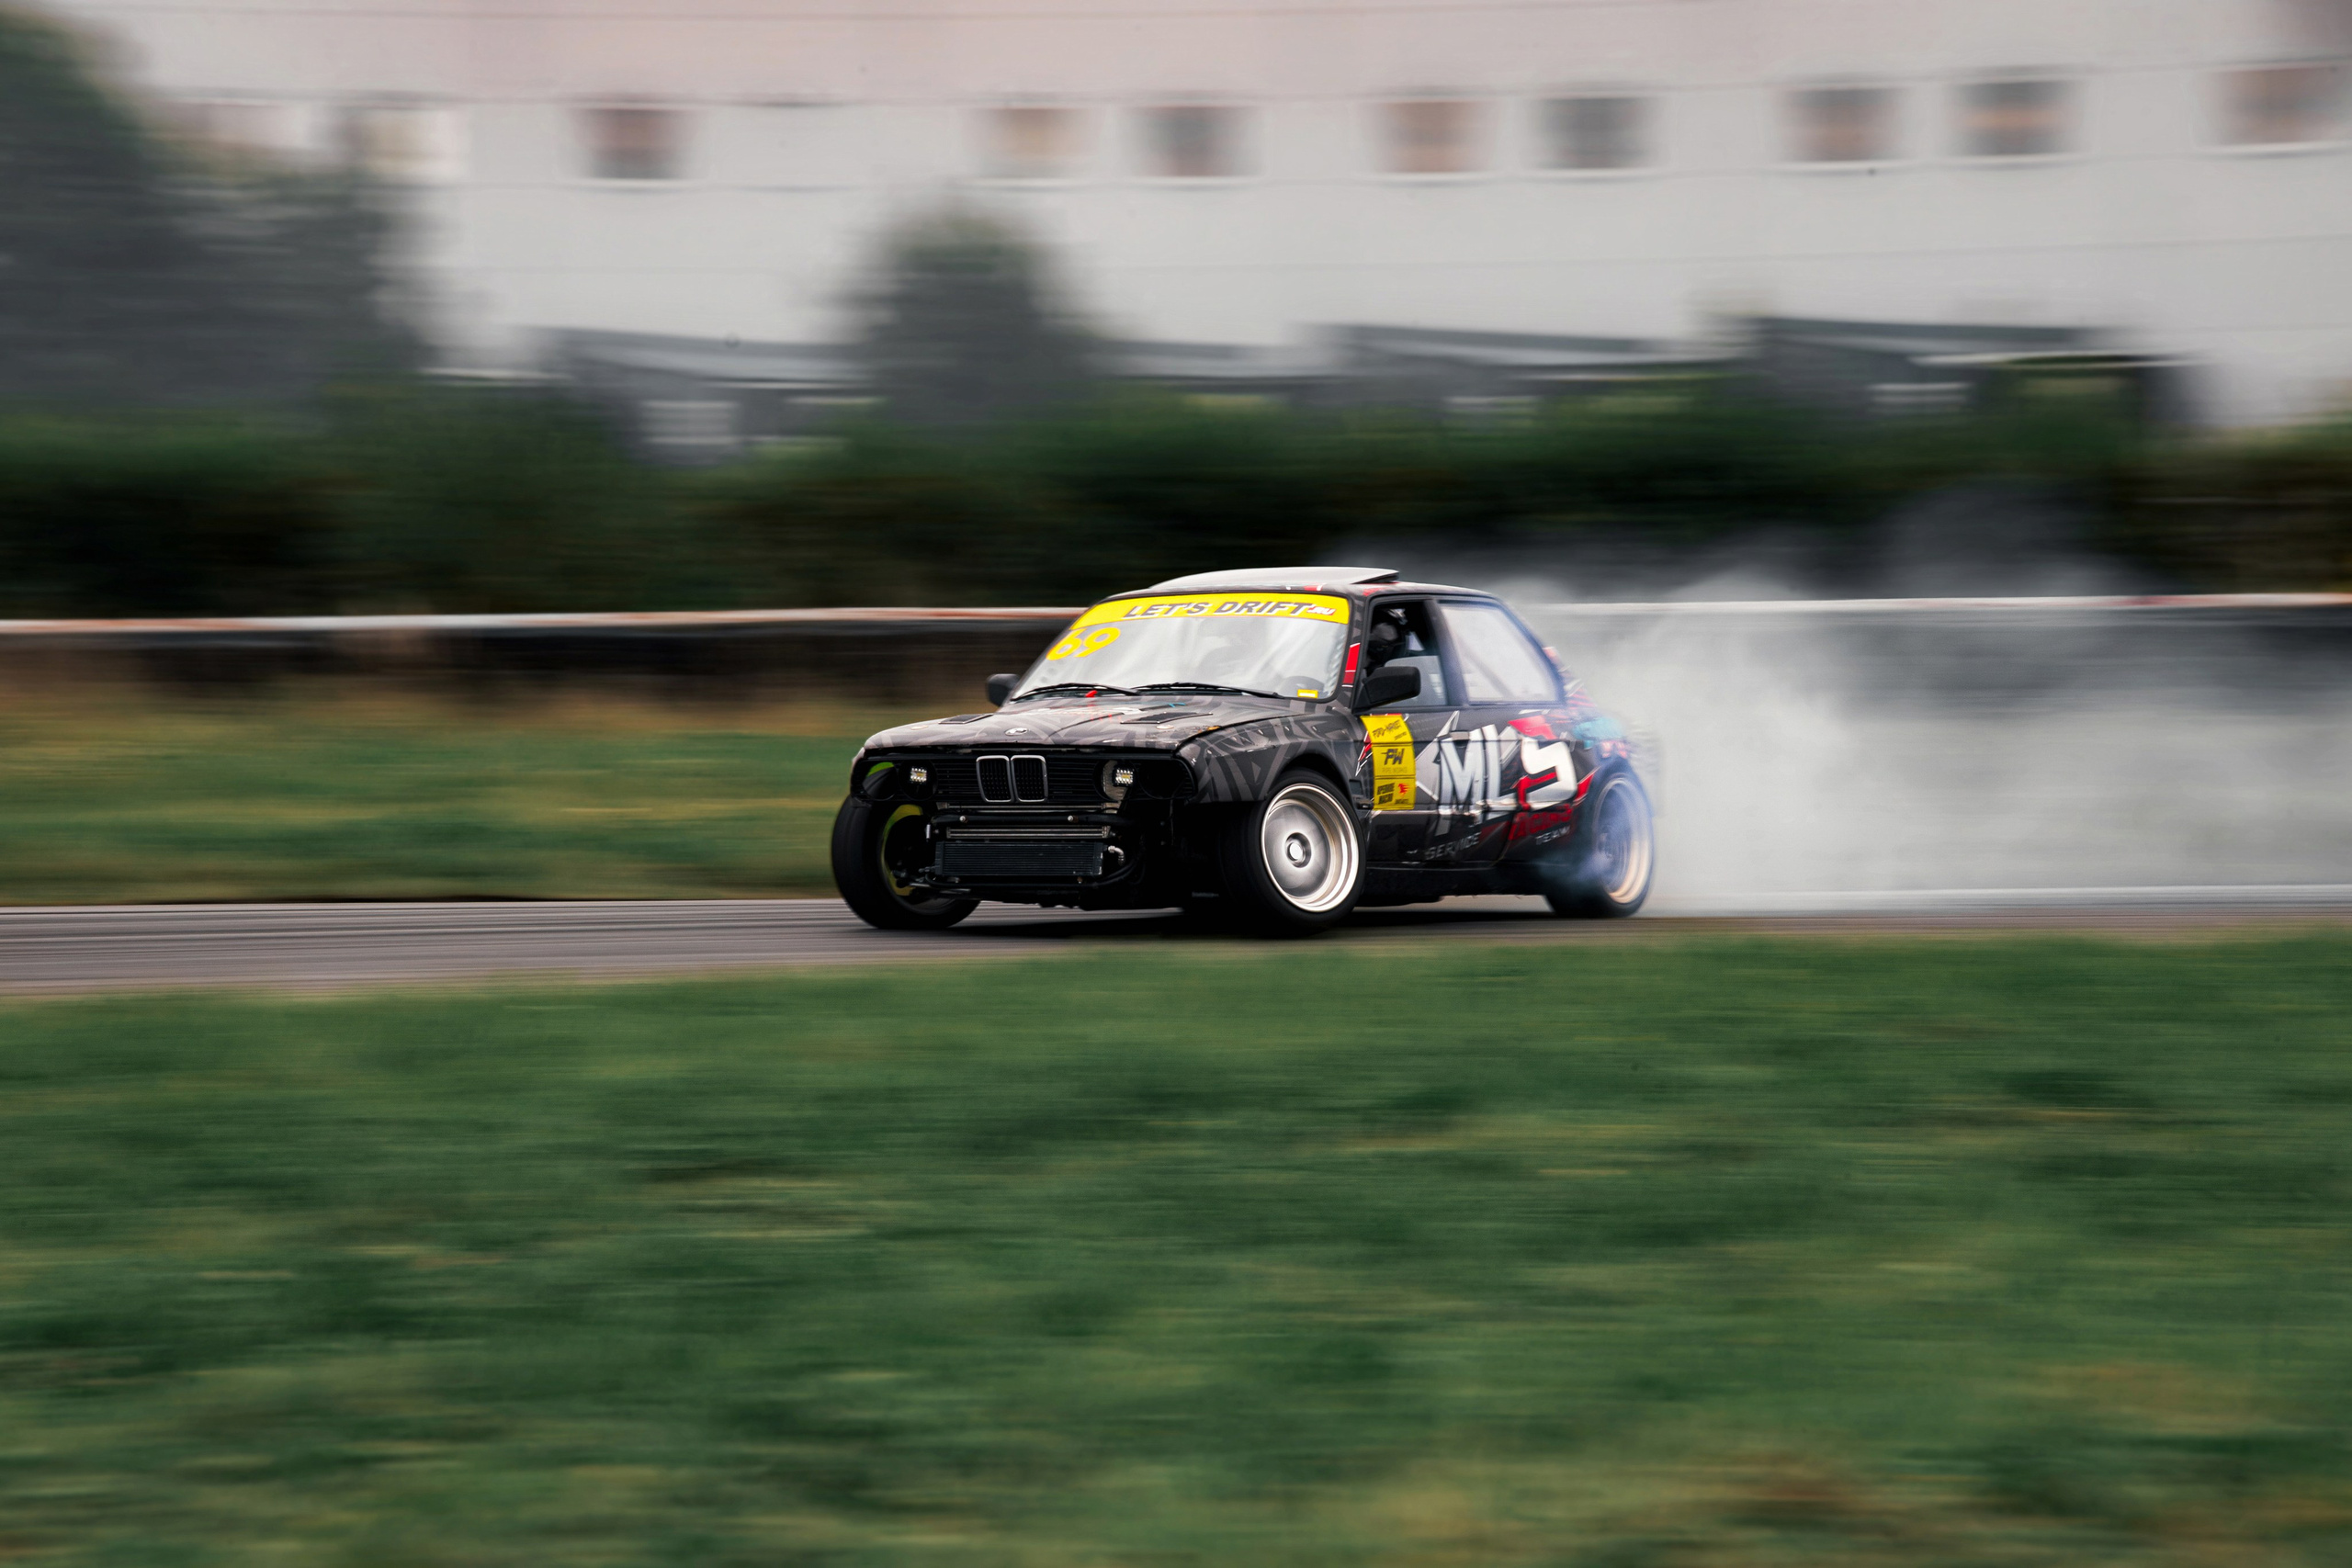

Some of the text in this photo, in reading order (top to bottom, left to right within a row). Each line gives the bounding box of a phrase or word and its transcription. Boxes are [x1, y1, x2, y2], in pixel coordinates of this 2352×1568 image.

[1121, 602, 1213, 620] LET'S
[1046, 626, 1121, 660] 69
[1425, 831, 1483, 861] SERVICE
